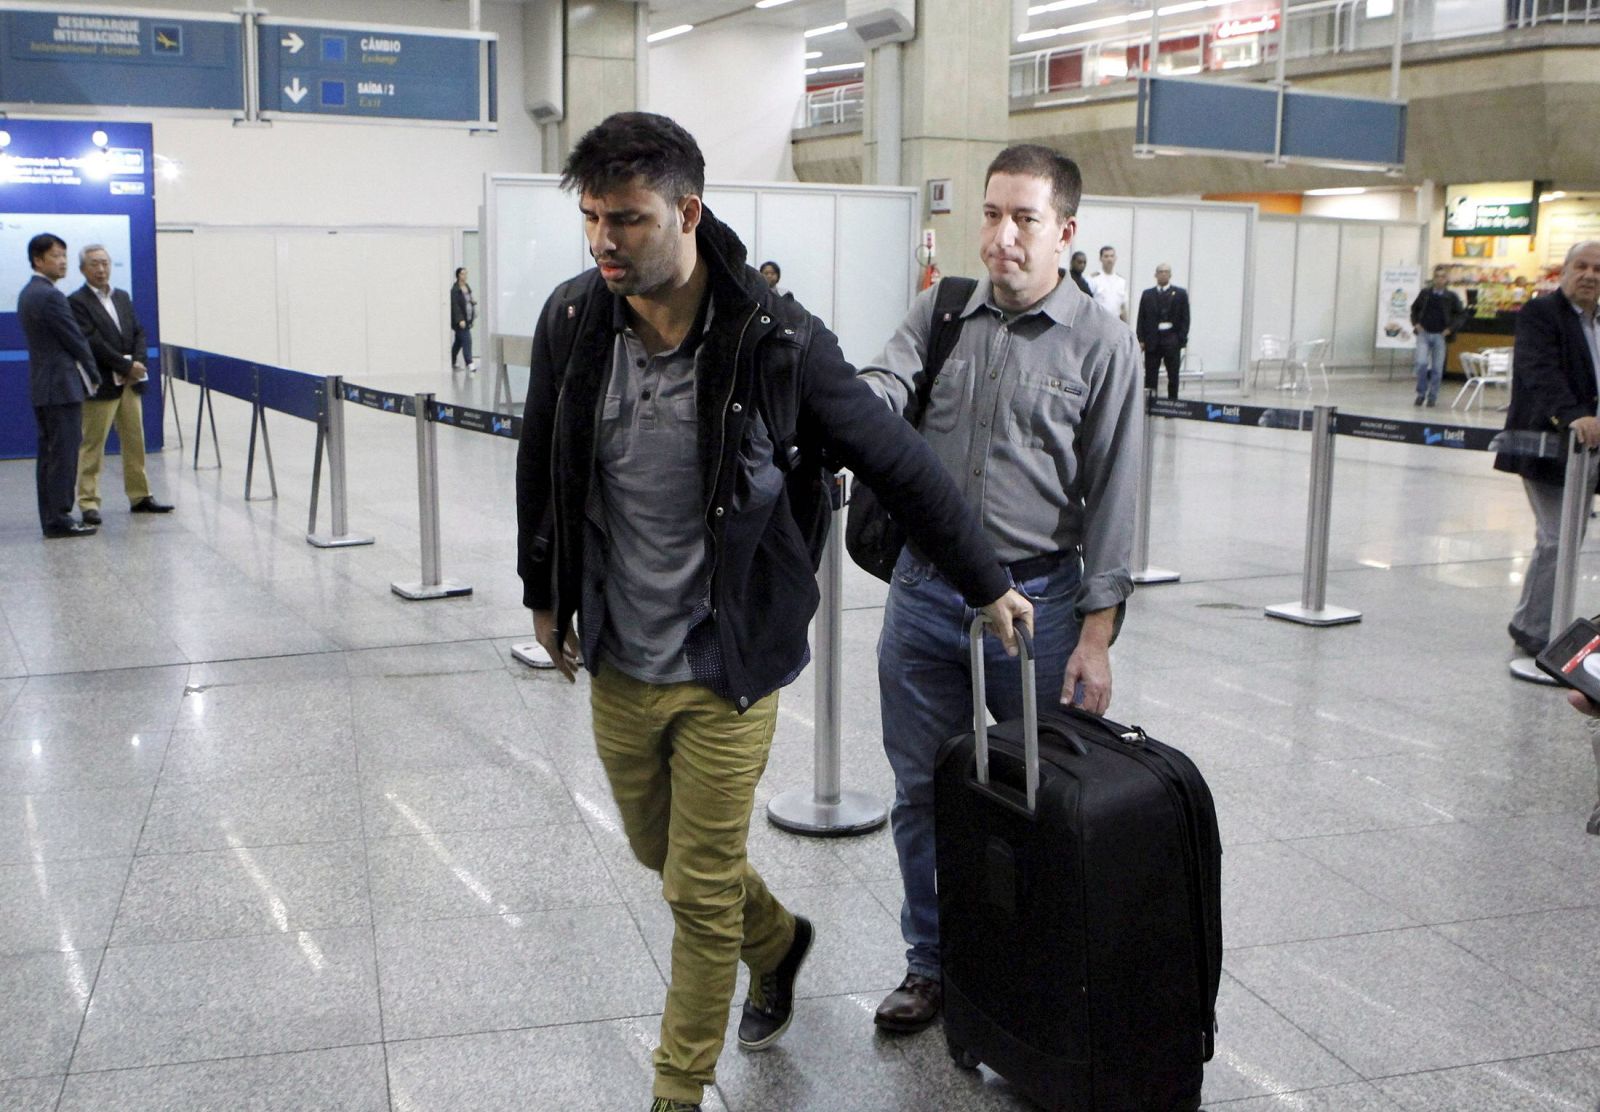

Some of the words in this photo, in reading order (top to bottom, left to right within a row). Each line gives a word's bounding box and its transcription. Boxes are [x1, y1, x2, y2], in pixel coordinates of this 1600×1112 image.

[57, 15, 140, 32] DESEMBARQUE
[53, 28, 140, 45] INTERNACIONAL
[360, 36, 401, 52] CÂMBIO
[357, 81, 383, 95] SAÍDA
[1222, 405, 1240, 416] belt
[1444, 429, 1465, 441] belt
